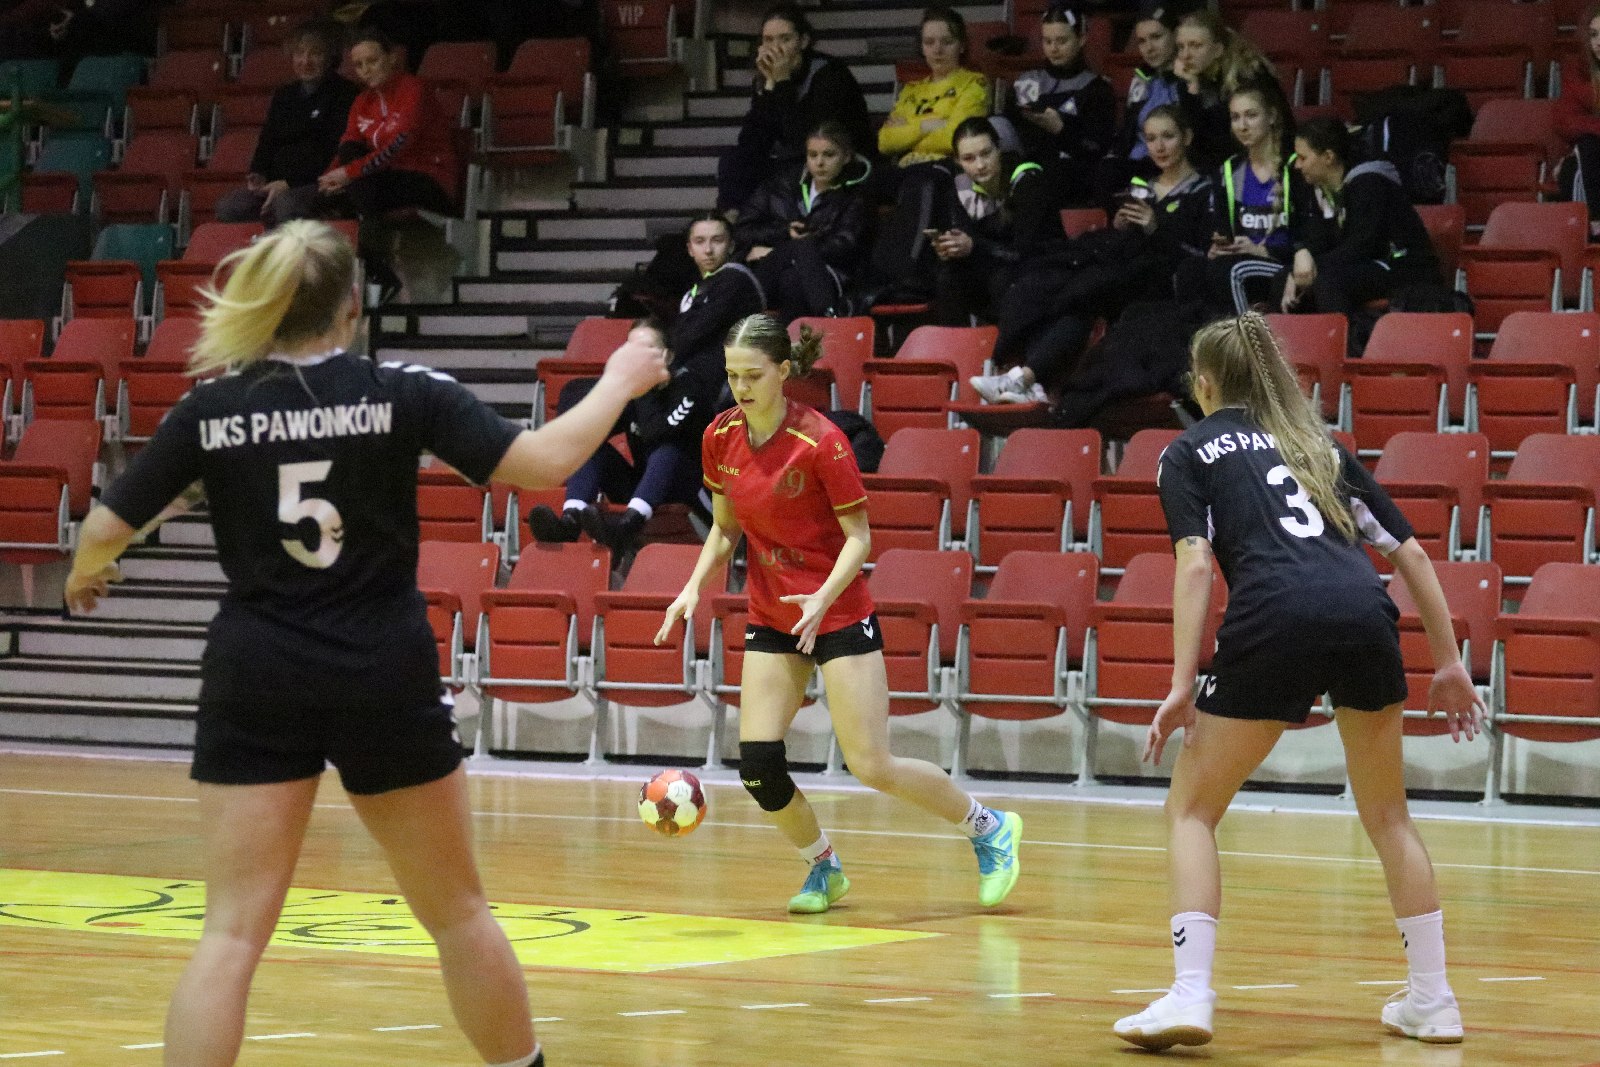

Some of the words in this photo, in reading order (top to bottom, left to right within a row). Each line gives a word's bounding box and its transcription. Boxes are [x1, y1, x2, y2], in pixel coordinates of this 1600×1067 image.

[618, 4, 644, 25] VIP
[199, 415, 247, 450] UKS
[251, 396, 392, 444] PAWONKÓW
[1196, 433, 1237, 464] UKS
[1235, 431, 1277, 451] PAW
[277, 460, 345, 569] 5
[1266, 464, 1325, 538] 3
